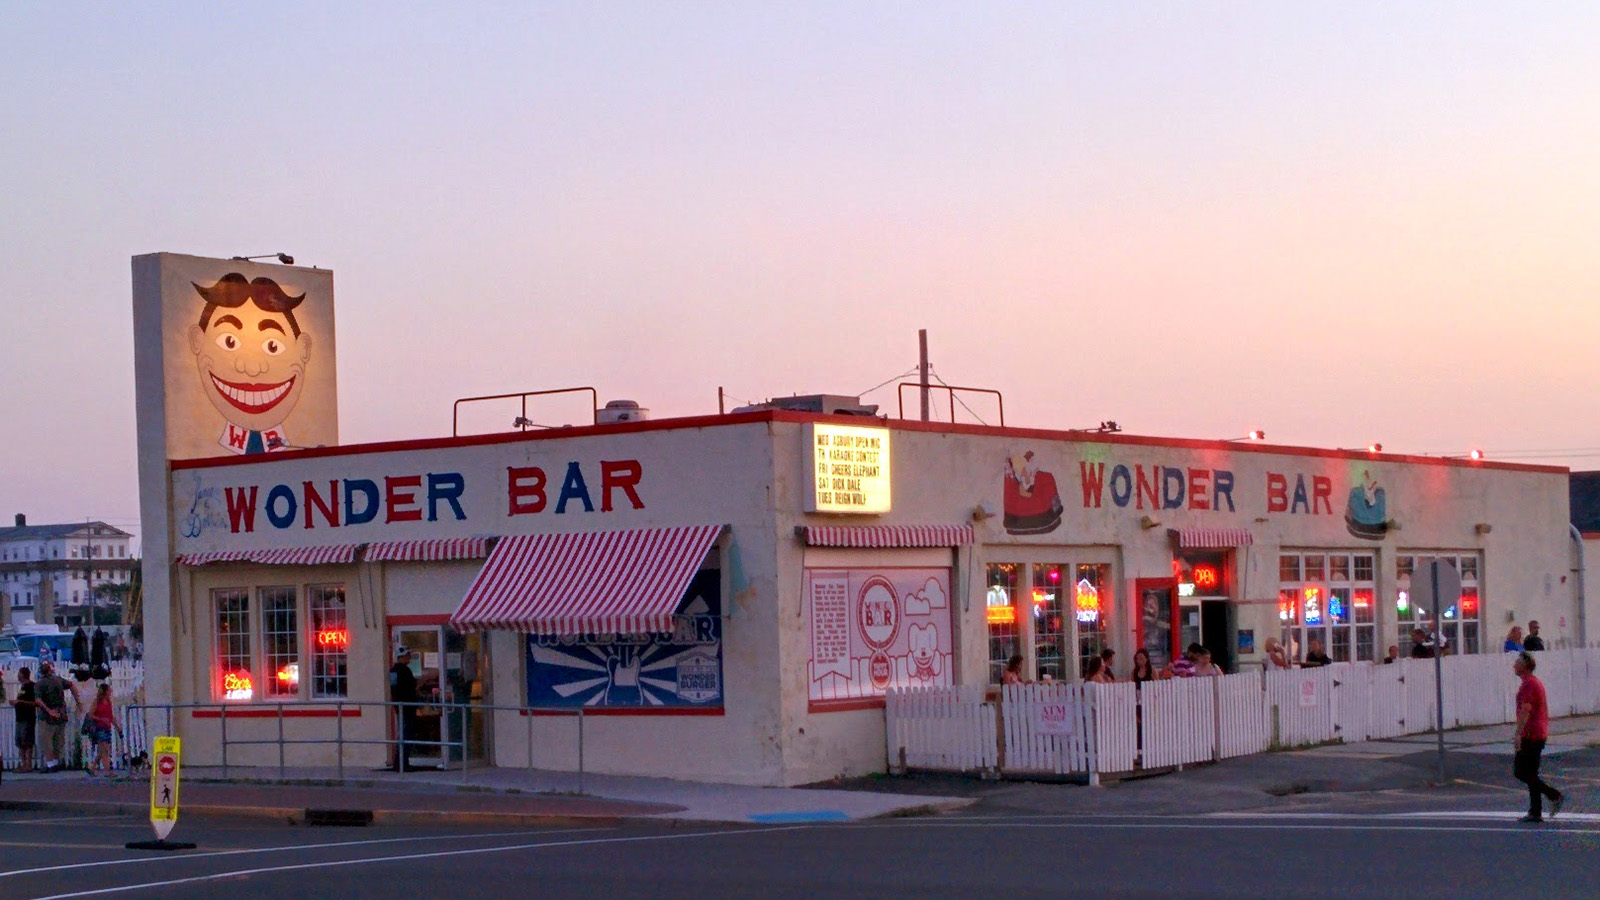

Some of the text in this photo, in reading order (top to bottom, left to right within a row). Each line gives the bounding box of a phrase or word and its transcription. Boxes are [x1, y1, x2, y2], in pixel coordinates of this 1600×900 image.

[229, 425, 248, 450] W
[855, 436, 868, 448] OPEN
[829, 449, 854, 462] KARAOKE
[855, 451, 879, 463] CONTEST
[818, 462, 879, 478] FRI CHEERS ELEPHANT
[818, 477, 861, 491] SAT DICK DALE
[1080, 460, 1334, 515] WONDER BAR
[224, 473, 467, 533] WONDER
[506, 459, 645, 517] BAR
[818, 491, 867, 505] TUES REIGN WOLF
[1194, 569, 1214, 584] OPEN
[319, 631, 347, 645] OPEN
[680, 673, 716, 681] WONDER
[680, 681, 716, 689] BURGER
[1042, 705, 1066, 715] ATM
